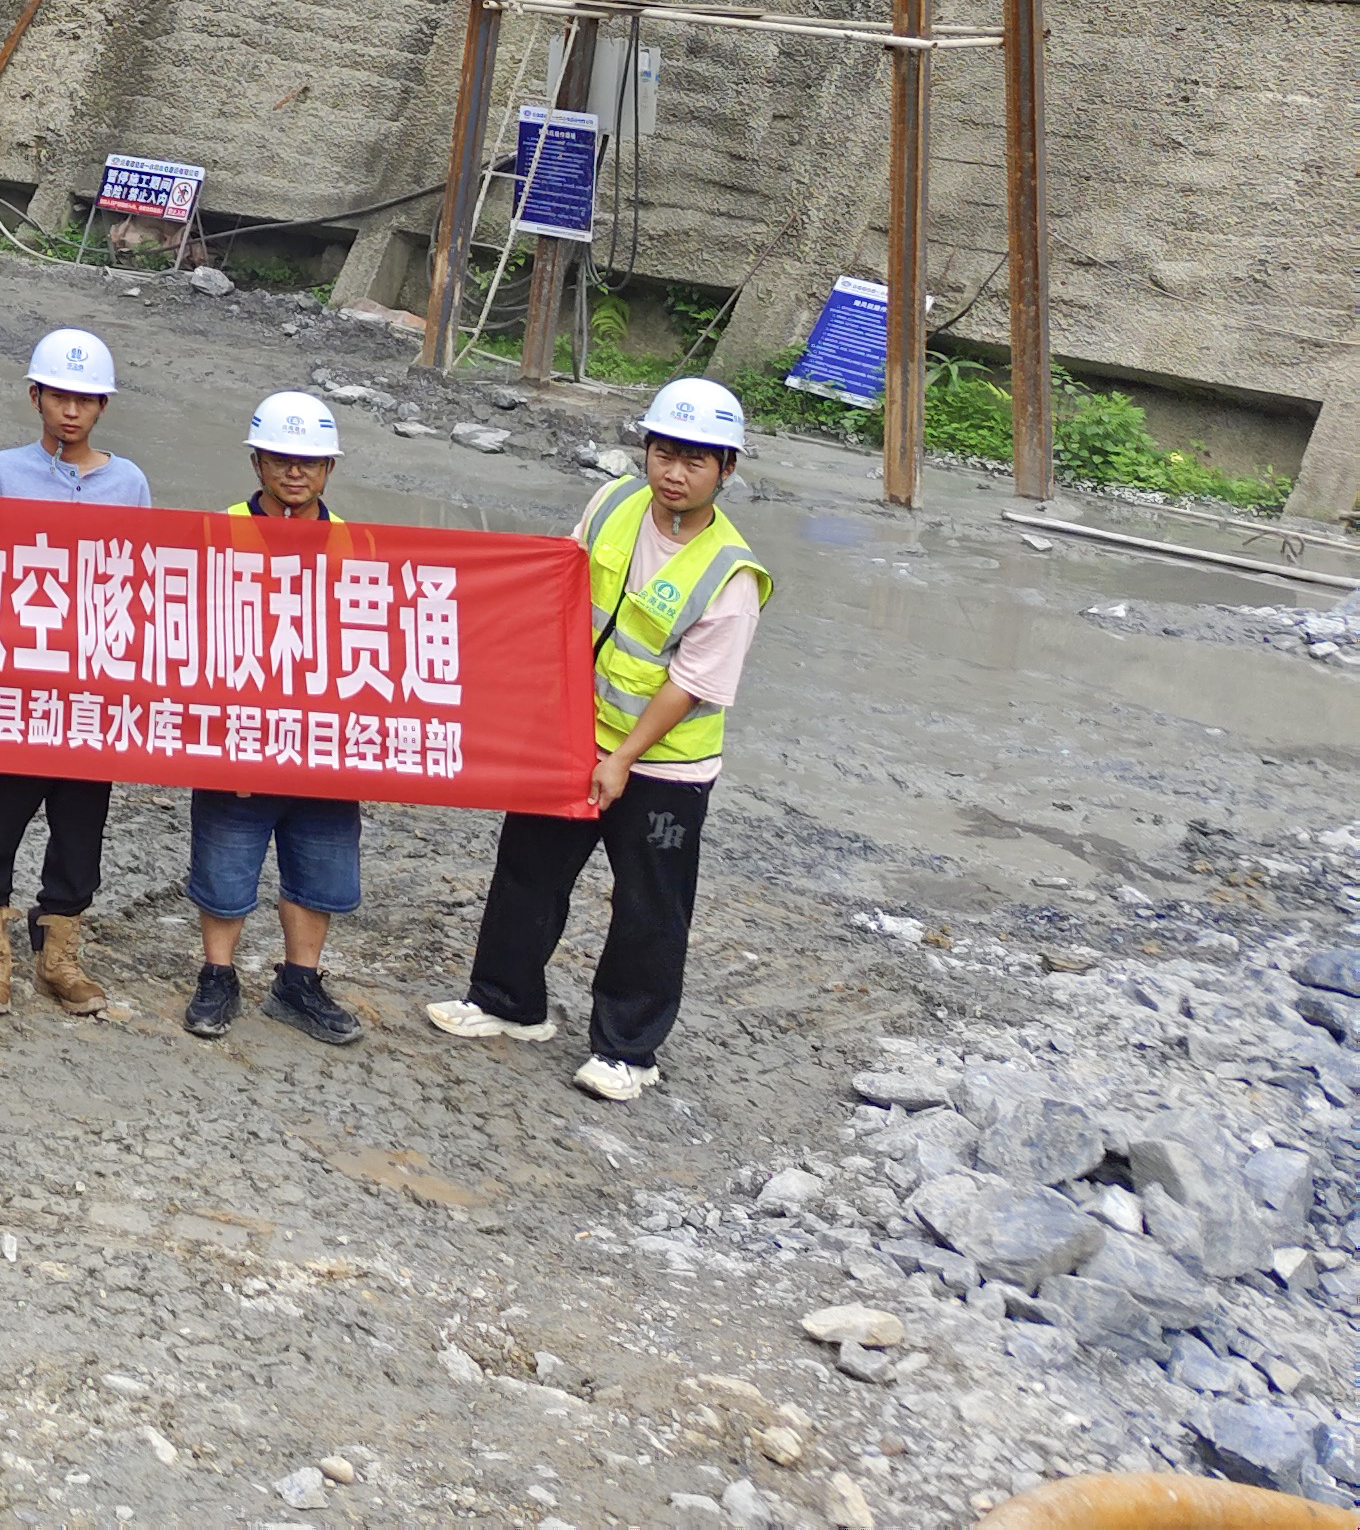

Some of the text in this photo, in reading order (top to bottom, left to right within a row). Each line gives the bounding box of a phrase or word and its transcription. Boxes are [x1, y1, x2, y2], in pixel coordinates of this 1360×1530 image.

[107, 169, 173, 191] 暂停施工期间
[640, 590, 677, 619] 云南建投
